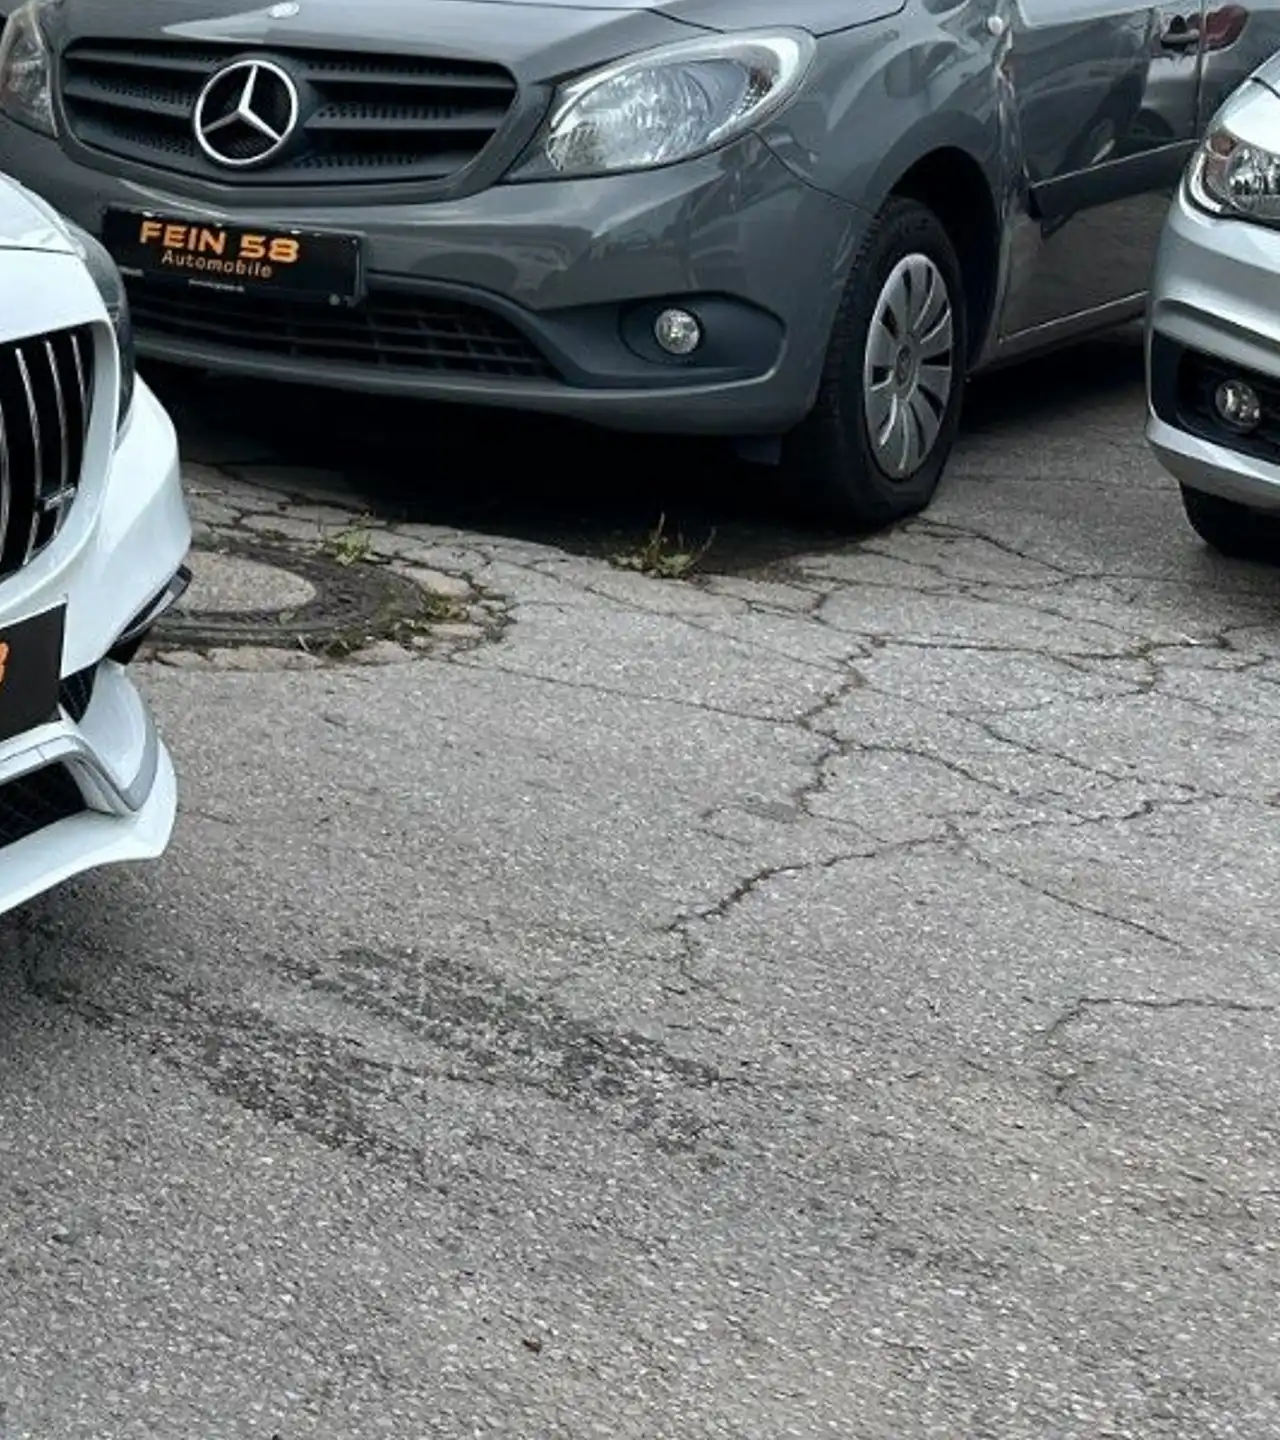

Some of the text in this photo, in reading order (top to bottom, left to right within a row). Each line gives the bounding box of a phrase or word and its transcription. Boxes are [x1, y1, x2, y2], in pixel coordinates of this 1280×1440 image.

[140, 221, 301, 263] FEIN 58
[161, 249, 273, 278] Automobile
